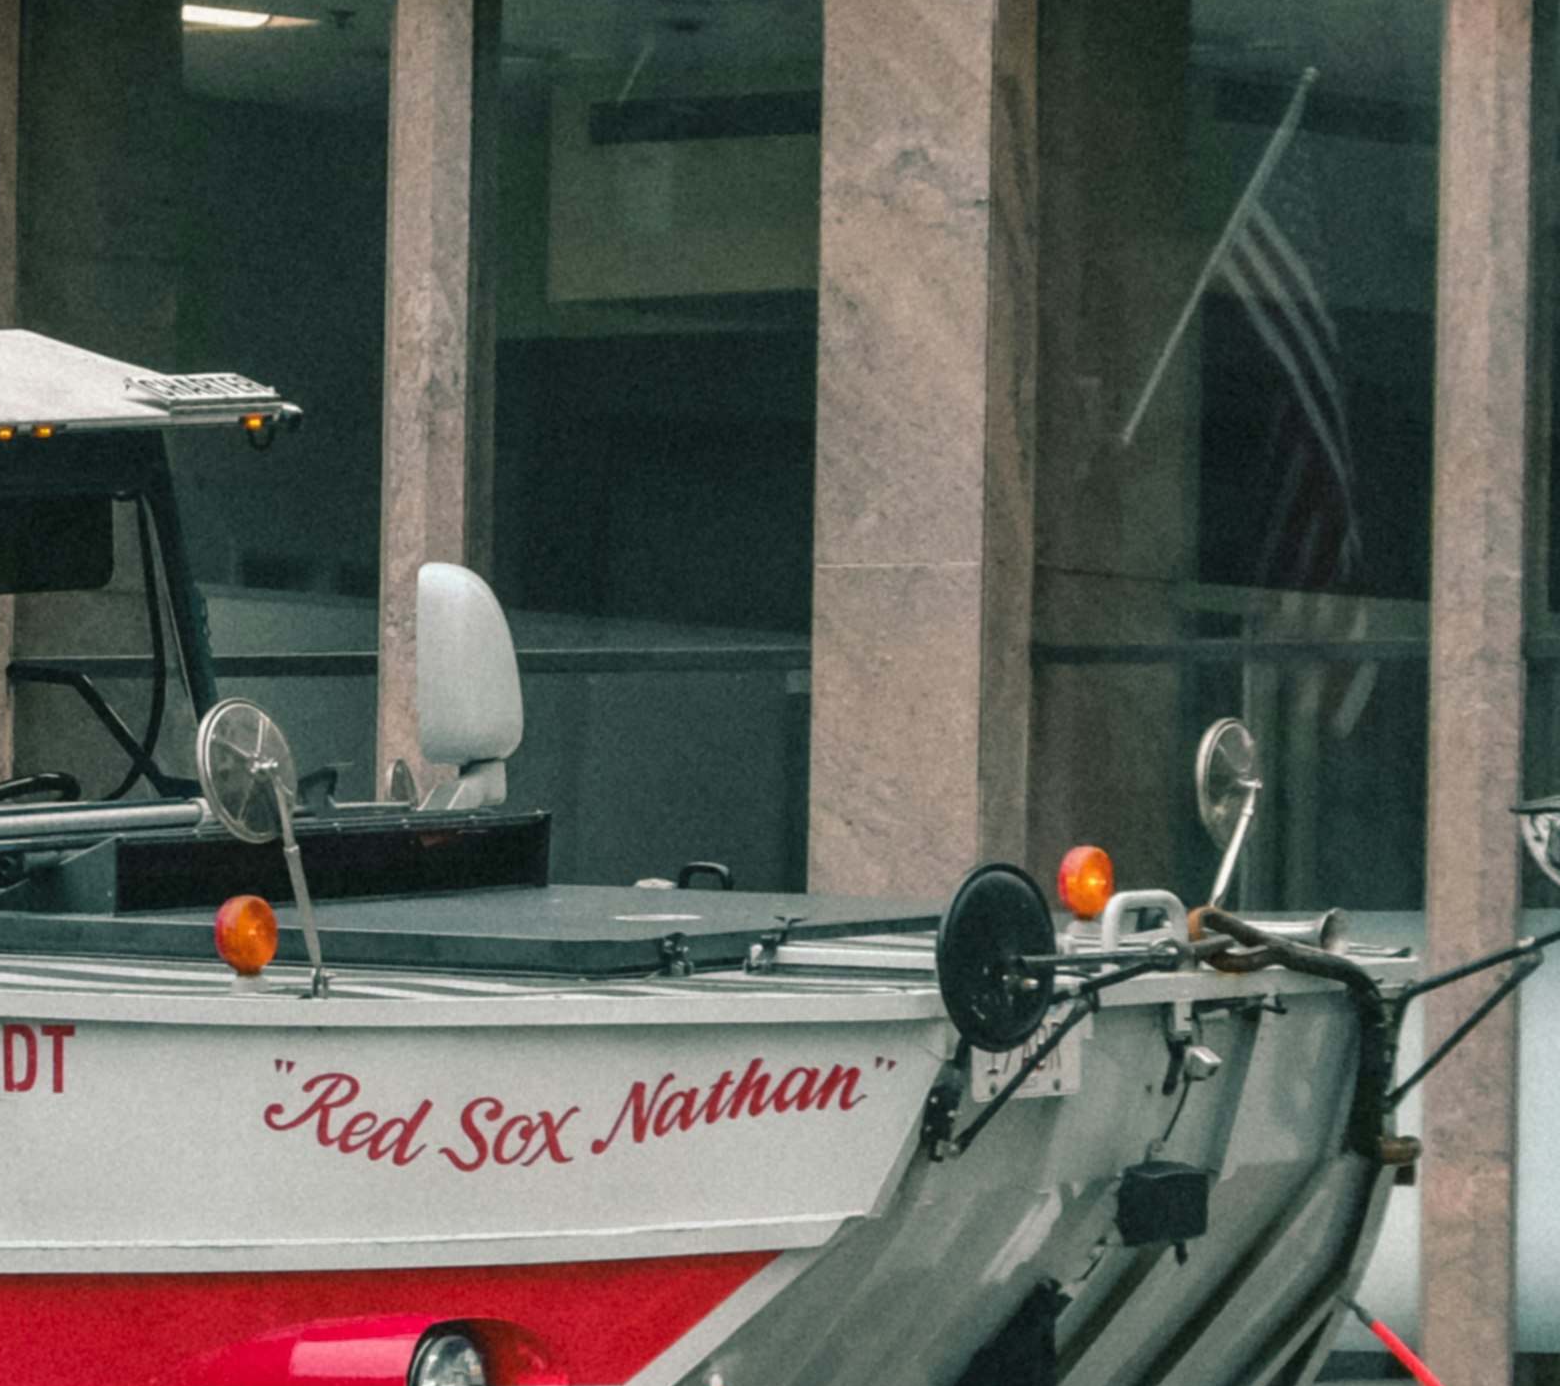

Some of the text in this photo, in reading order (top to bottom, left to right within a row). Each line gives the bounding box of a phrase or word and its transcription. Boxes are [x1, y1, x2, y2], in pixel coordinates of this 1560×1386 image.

[138, 376, 262, 396] CHARTER
[3, 1024, 76, 1094] DT
[438, 1096, 580, 1173] Sox
